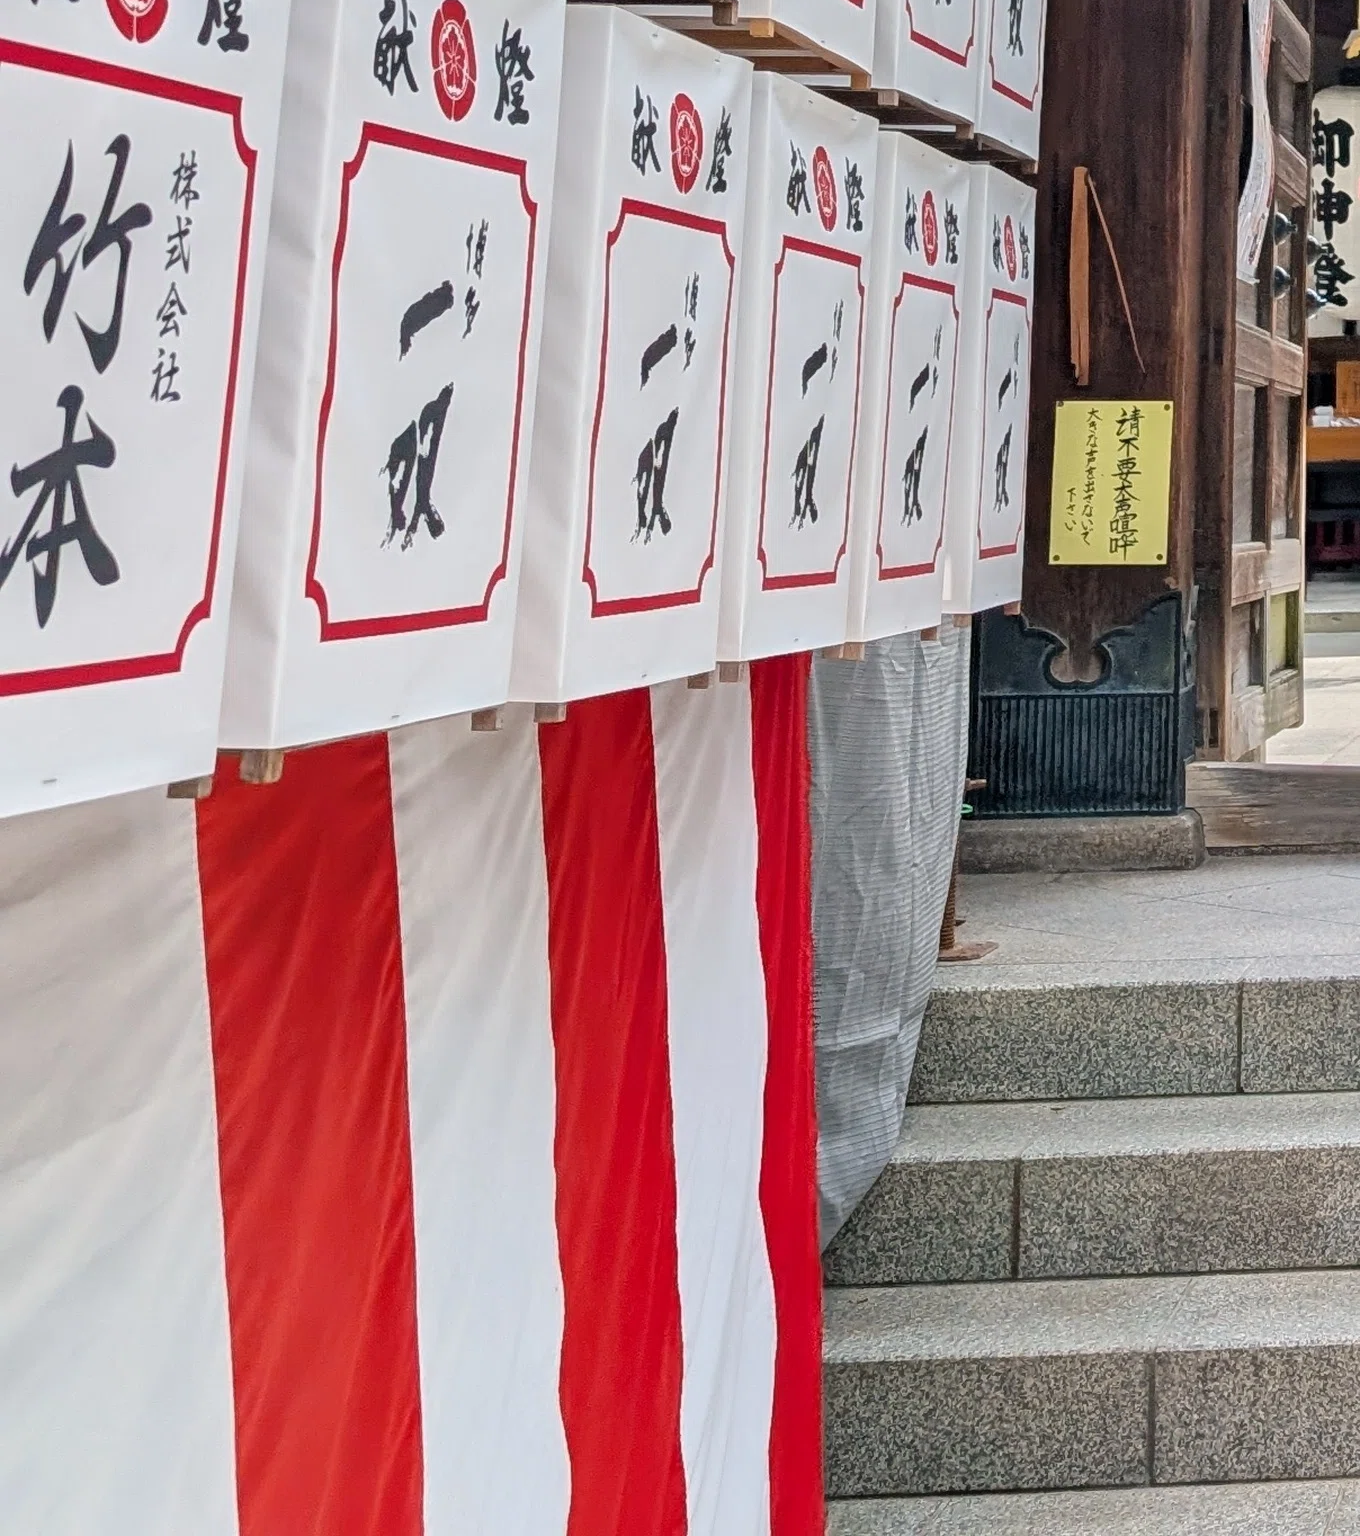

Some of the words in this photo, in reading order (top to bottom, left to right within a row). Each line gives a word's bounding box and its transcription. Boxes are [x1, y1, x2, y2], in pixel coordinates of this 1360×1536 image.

[631, 85, 661, 176] 献
[0, 134, 152, 629] 竹本
[151, 150, 199, 401] 株式会社
[379, 280, 454, 551] 一双
[630, 324, 679, 545] 一双
[1064, 487, 1077, 532] 下さい
[1080, 407, 1103, 546] 大きな声を出さないで
